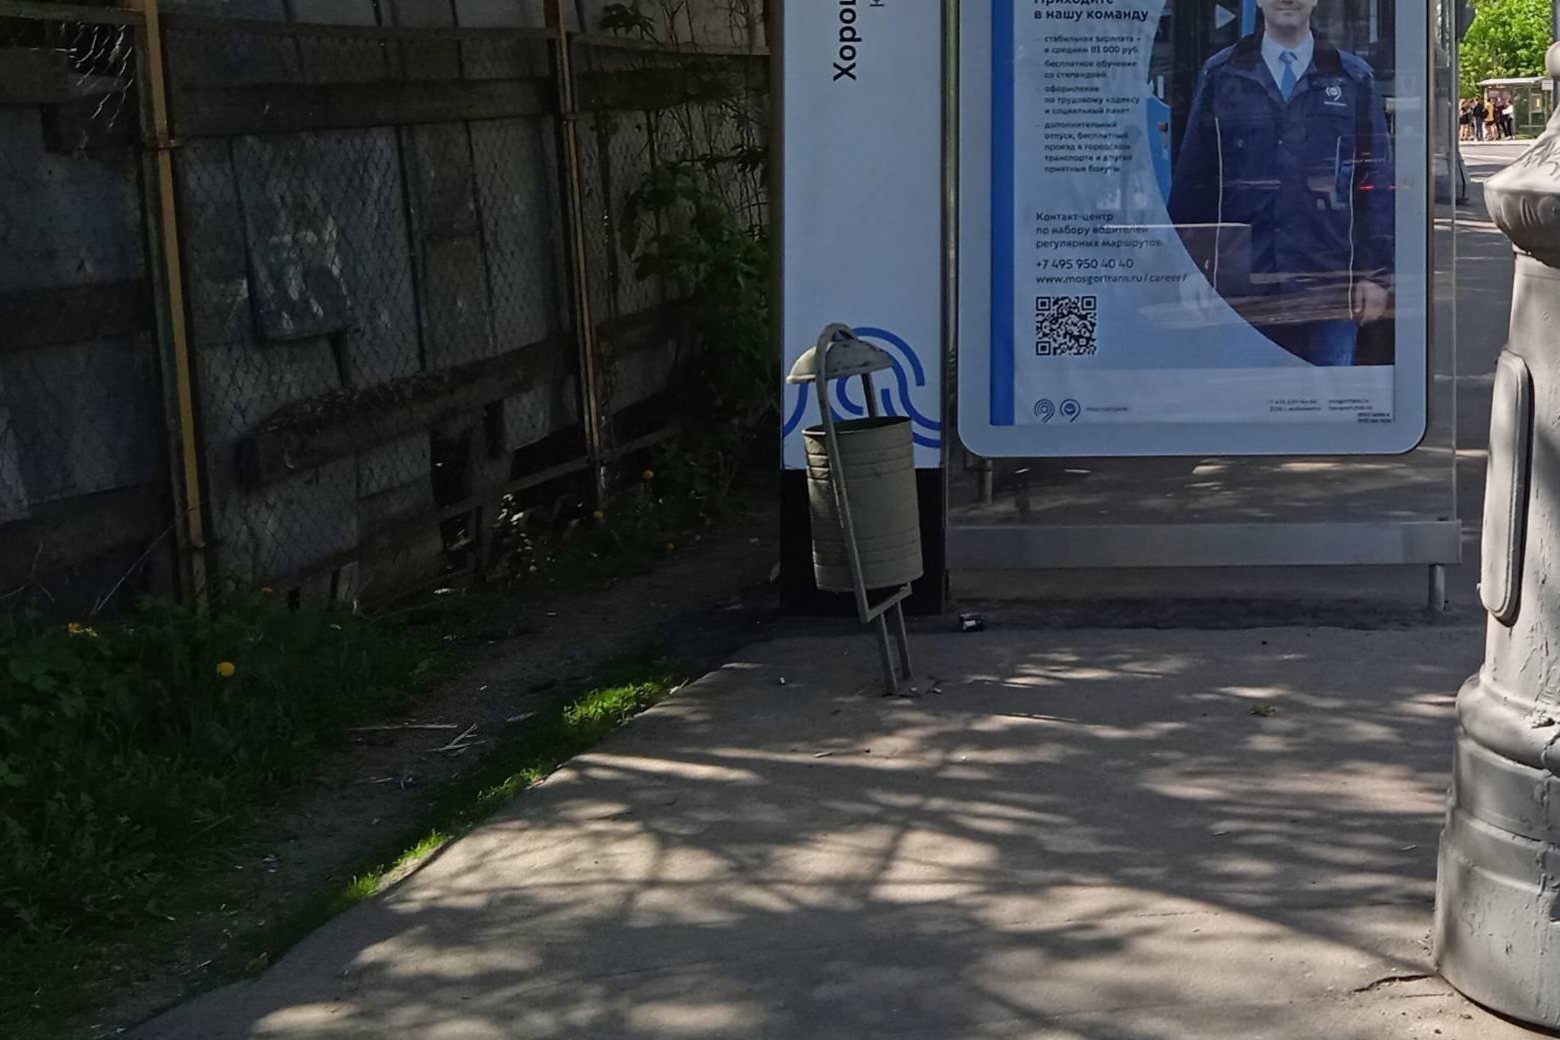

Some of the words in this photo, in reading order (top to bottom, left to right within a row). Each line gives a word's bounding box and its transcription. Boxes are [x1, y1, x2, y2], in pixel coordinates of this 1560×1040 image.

[1034, 11, 1042, 20] в
[1046, 10, 1082, 23] нашу
[1086, 10, 1149, 23] команду
[1036, 227, 1048, 235] по
[1036, 259, 1048, 269] +7
[1051, 258, 1073, 270] 495
[1076, 258, 1098, 269] 950
[1101, 258, 1115, 269] 40
[1118, 258, 1134, 269] 40
